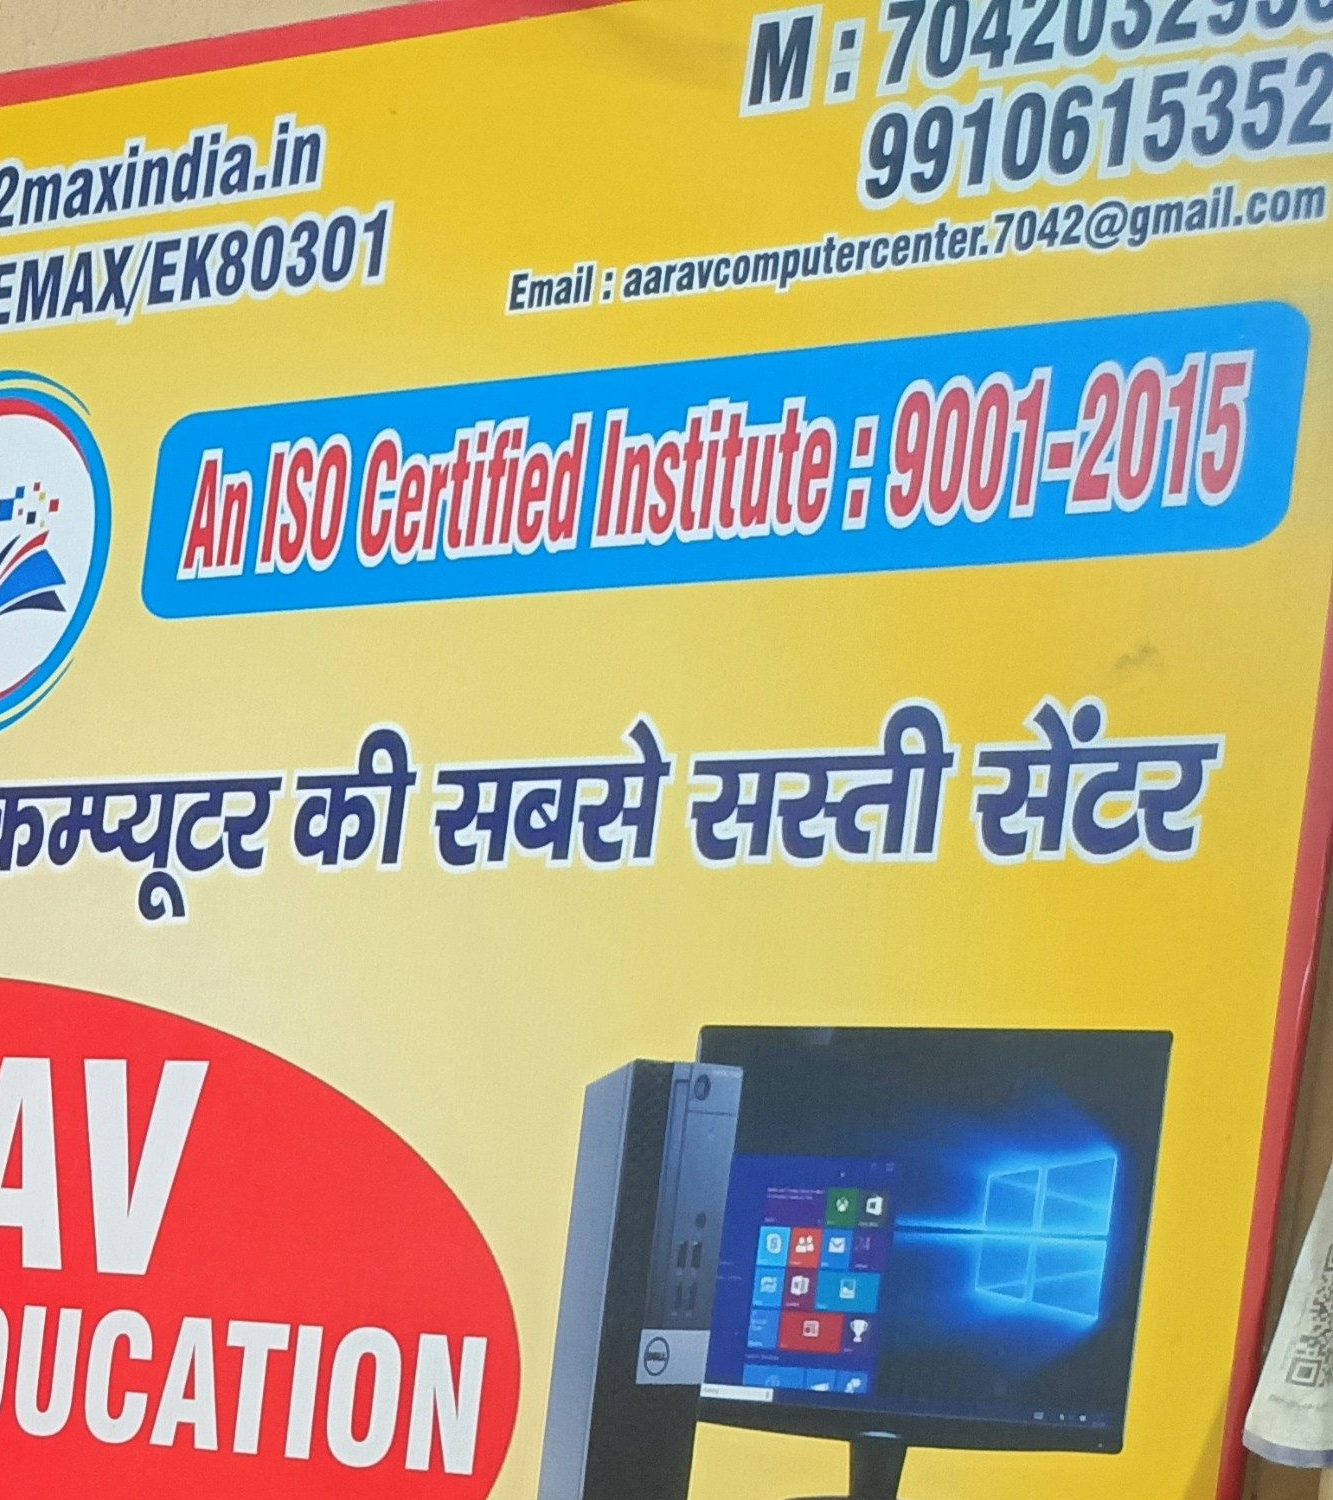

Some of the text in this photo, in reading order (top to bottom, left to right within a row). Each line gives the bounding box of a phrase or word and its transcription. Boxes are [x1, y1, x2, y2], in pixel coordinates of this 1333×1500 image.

[749, 17, 816, 107] M
[865, 52, 1333, 200] 9910615352
[509, 267, 592, 310] Email
[622, 184, 1326, 300] aaravcomputercenter.7042@gmail.com
[183, 459, 245, 573] An
[259, 445, 347, 565] ISO
[361, 424, 574, 557] Certified
[594, 403, 828, 540] Institute
[890, 362, 1250, 517] 9001-2015
[295, 728, 413, 866] की
[434, 721, 668, 863] सबसे
[693, 707, 954, 861] सस्ती
[977, 700, 1218, 858] सेंटर
